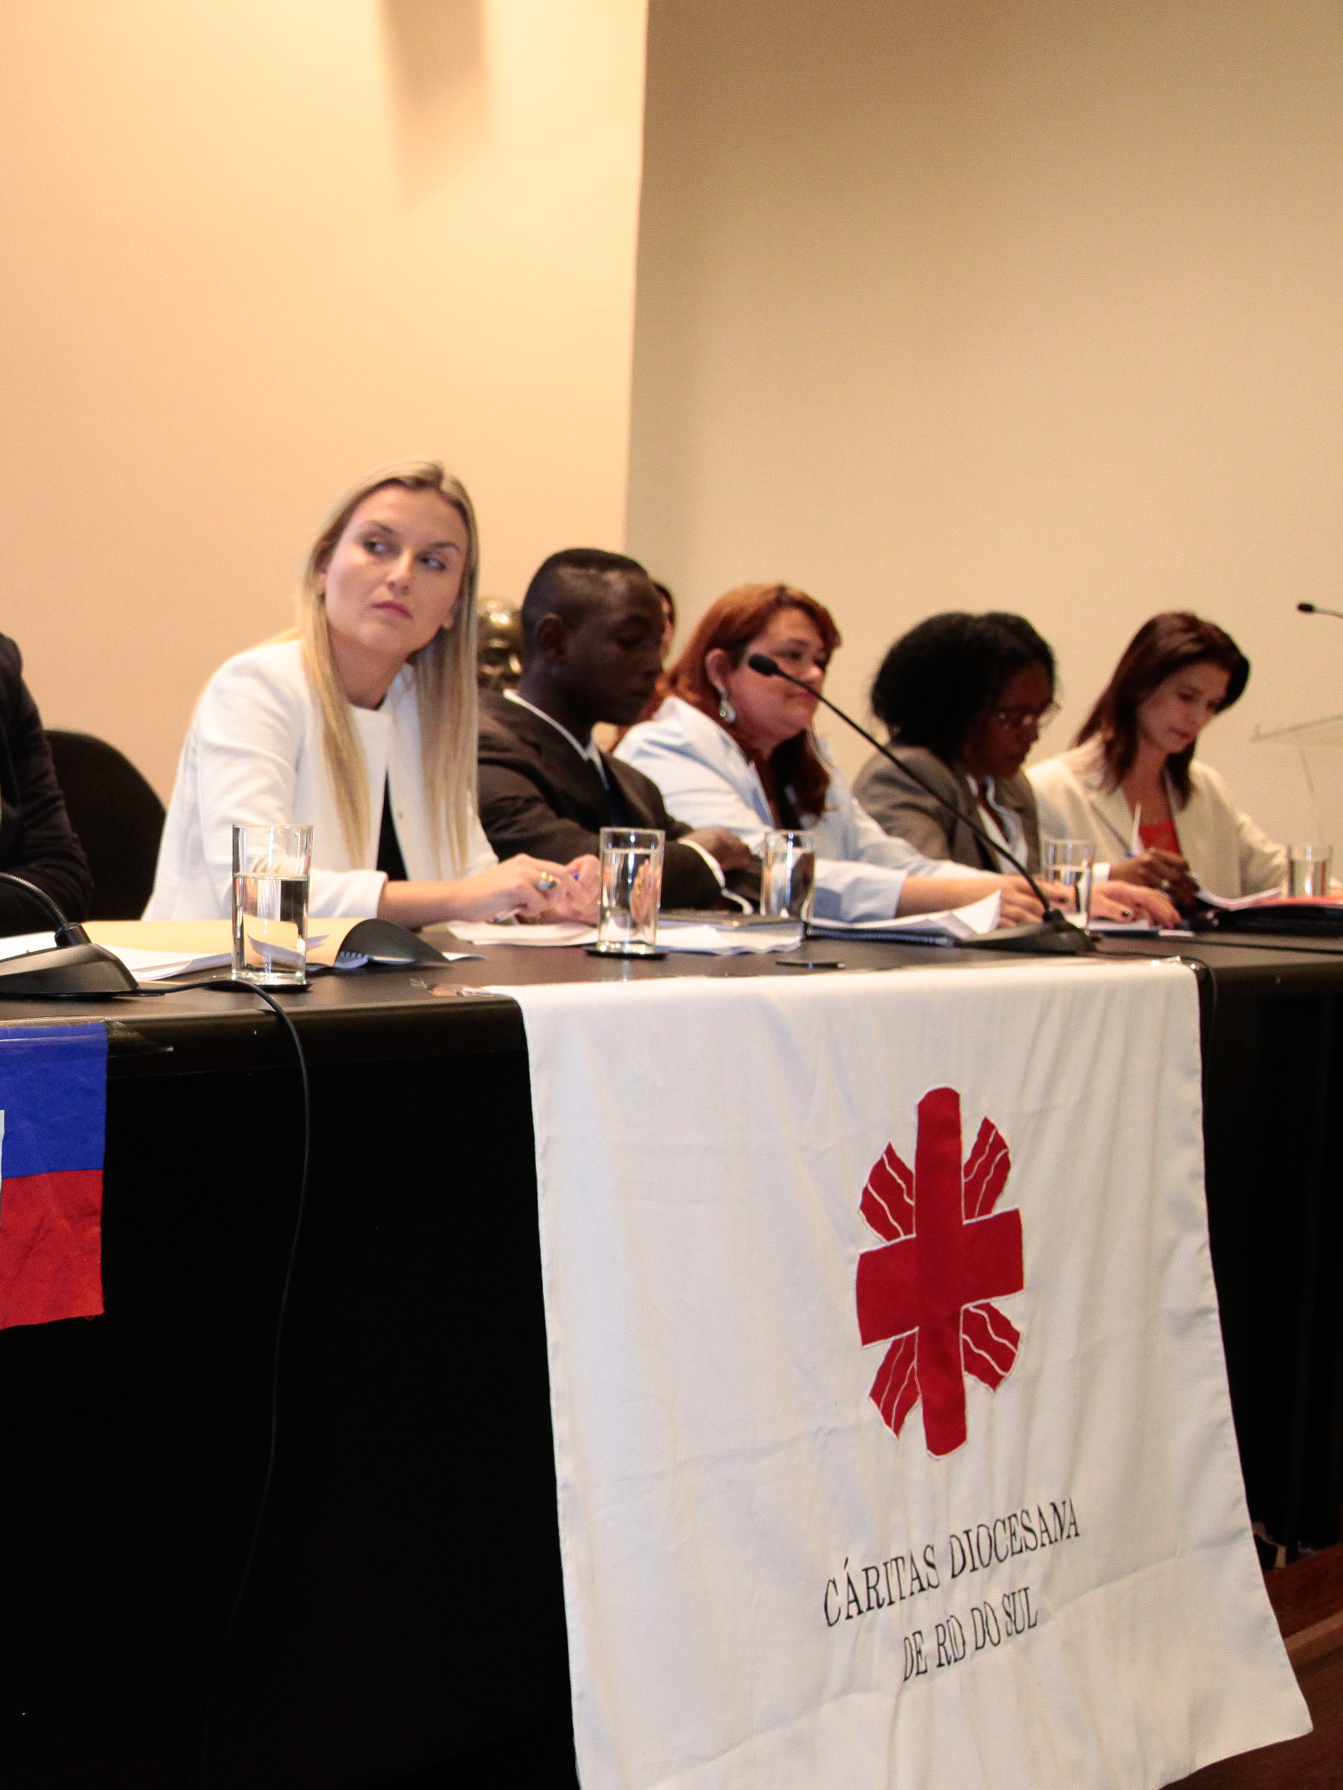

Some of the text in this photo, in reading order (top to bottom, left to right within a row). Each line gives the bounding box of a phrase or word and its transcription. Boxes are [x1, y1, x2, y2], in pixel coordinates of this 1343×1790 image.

[824, 1498, 1080, 1627] CÁRITAS DIOCESANA
[903, 1631, 928, 1681] DE
[971, 1601, 1001, 1651] DO
[1002, 1587, 1038, 1637] SUL
